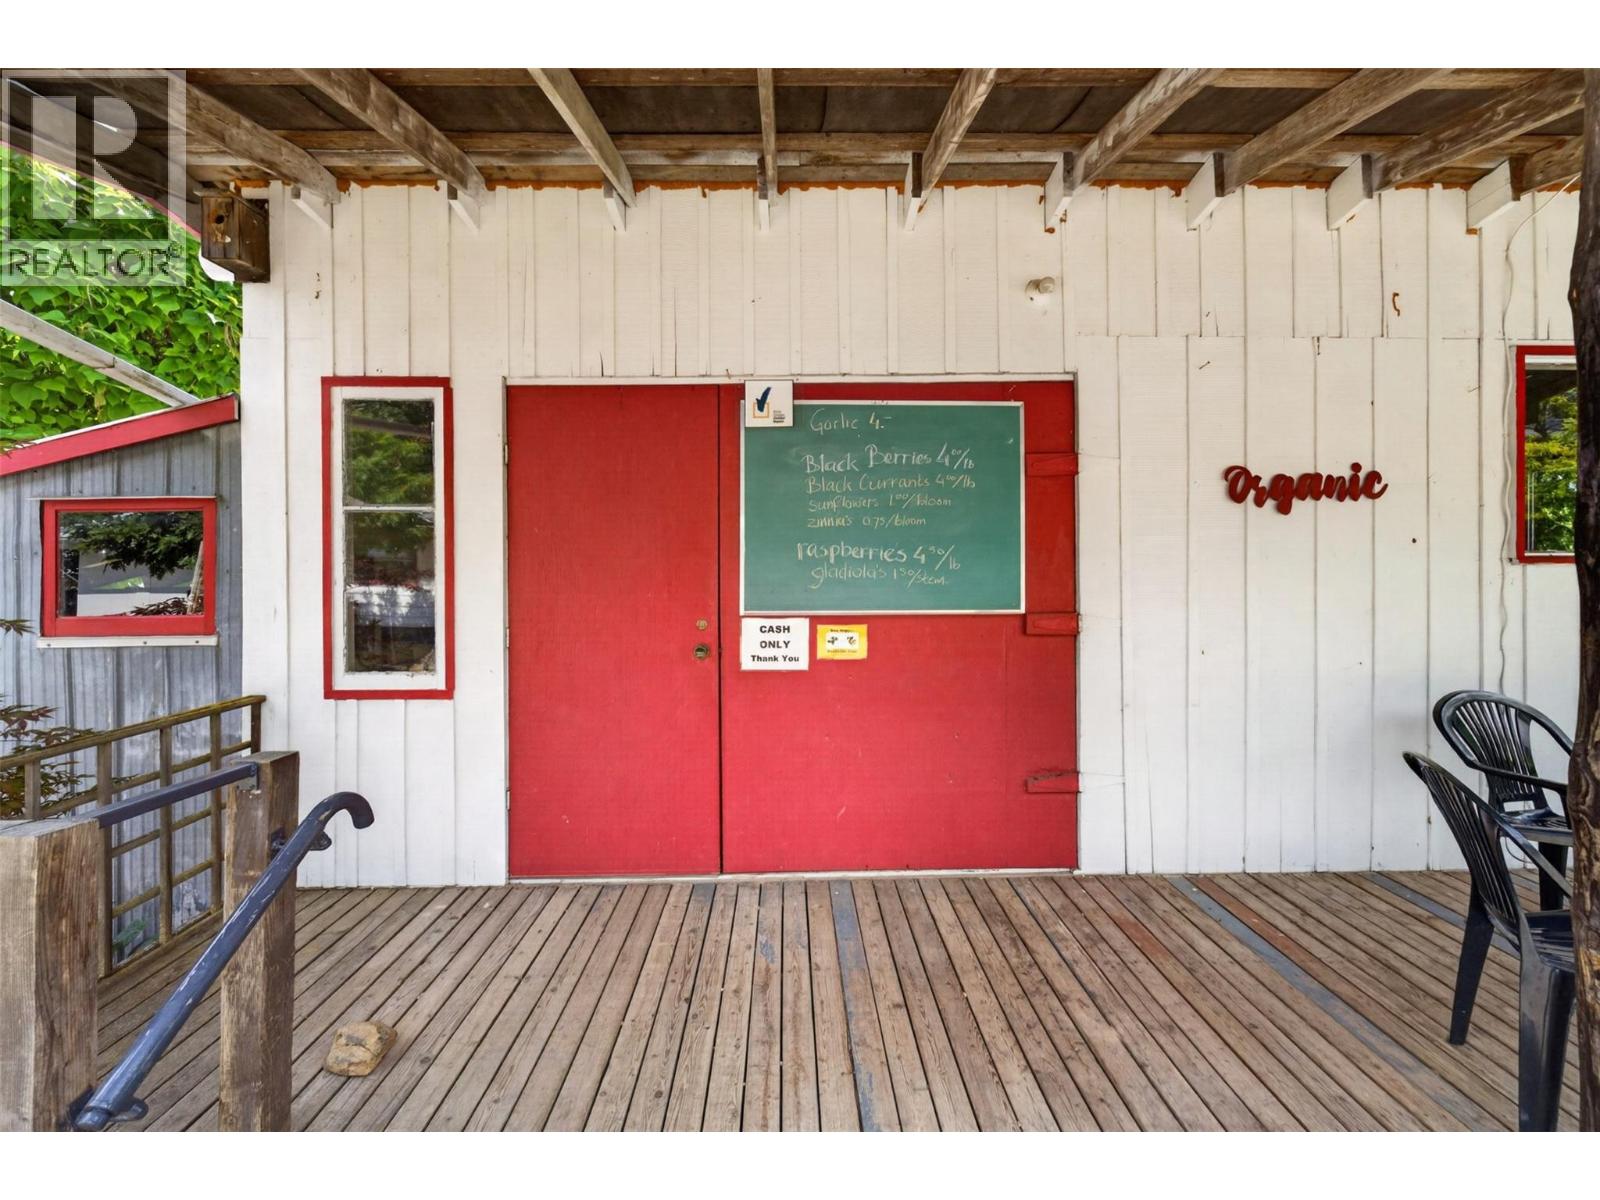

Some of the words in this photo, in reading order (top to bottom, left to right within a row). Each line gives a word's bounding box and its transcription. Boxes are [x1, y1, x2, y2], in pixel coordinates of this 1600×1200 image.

[810, 407, 858, 435] Garlic
[800, 452, 859, 474] Black
[864, 443, 933, 468] Berries
[805, 475, 852, 494] Black
[859, 473, 930, 491] Currants
[1223, 462, 1389, 515] Organic
[759, 625, 791, 634] CASH
[759, 640, 791, 649] ONLY
